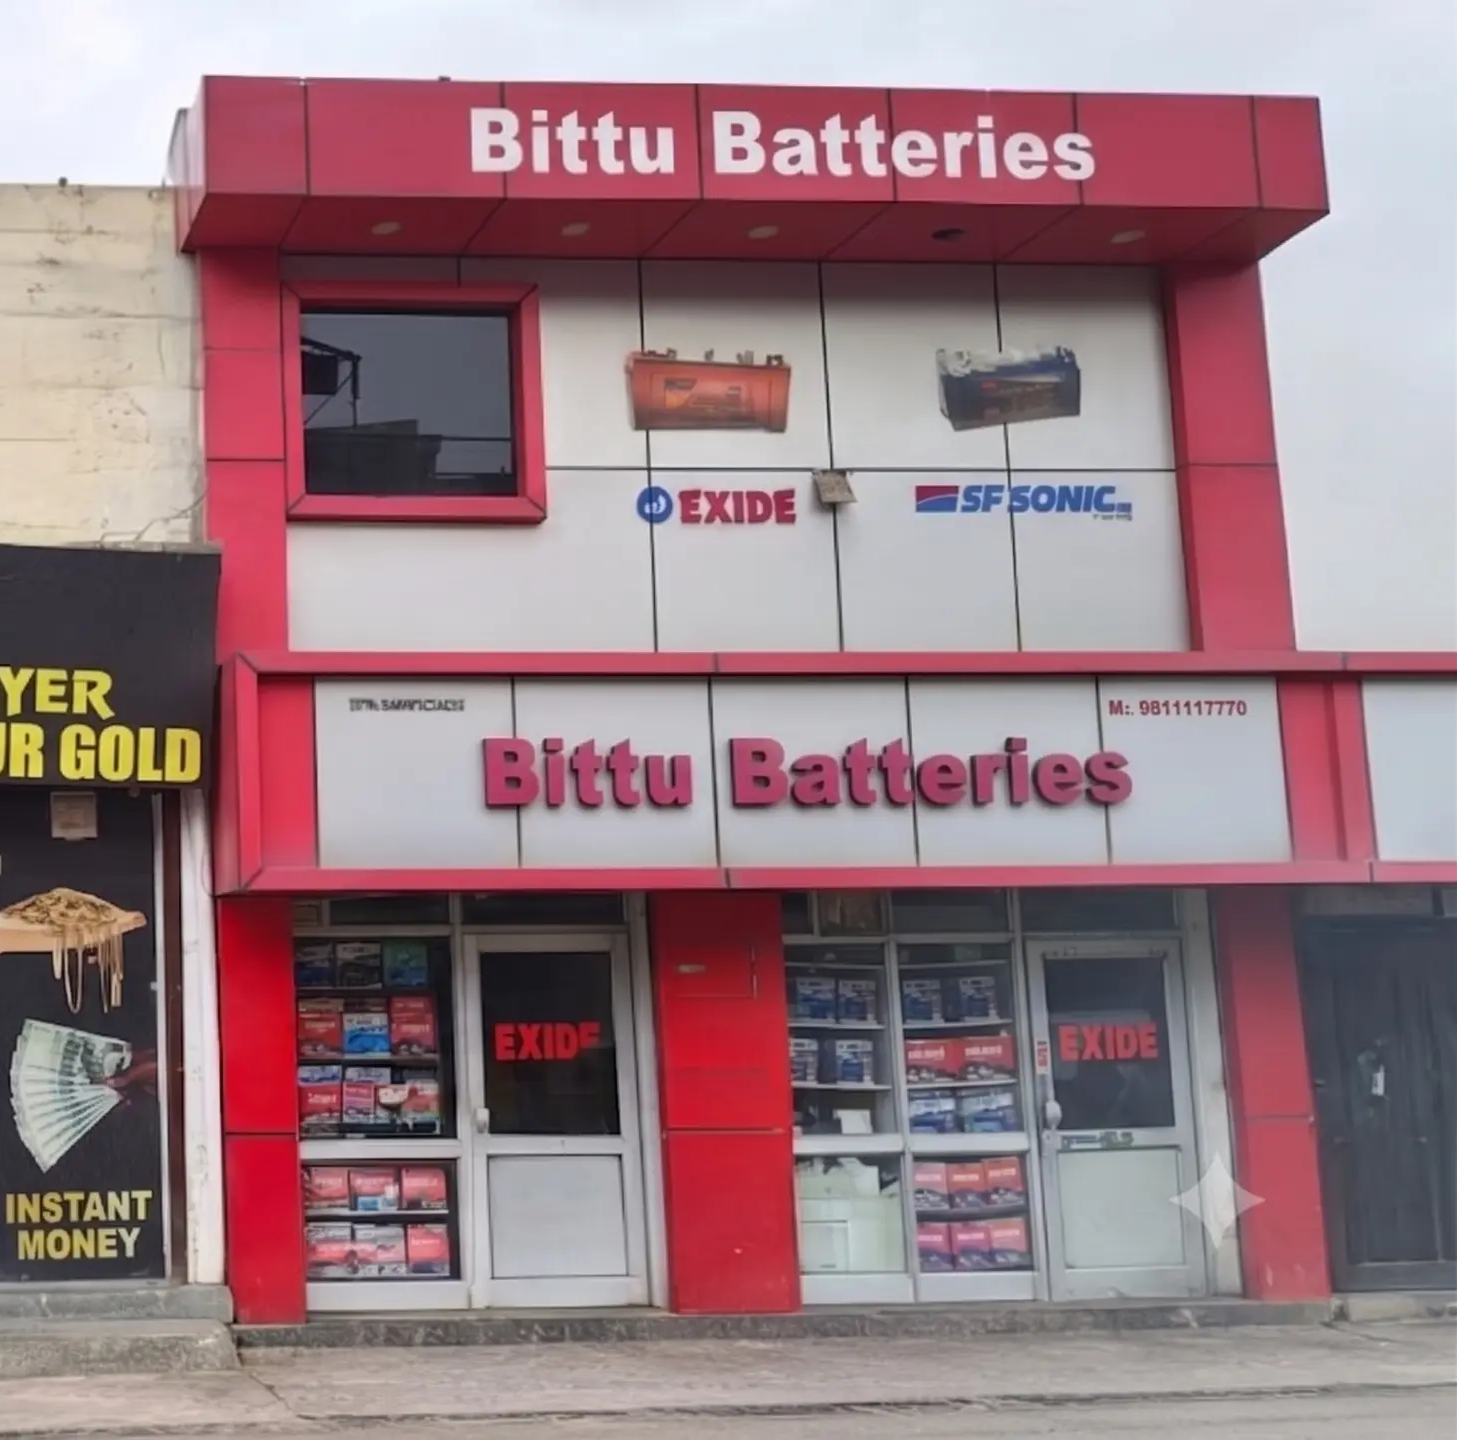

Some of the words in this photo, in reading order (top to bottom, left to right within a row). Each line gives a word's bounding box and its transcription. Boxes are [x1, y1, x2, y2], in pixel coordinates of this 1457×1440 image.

[470, 108, 675, 174] Bittu
[711, 110, 1095, 180] Batteries
[678, 488, 796, 525] EXIDE
[961, 484, 1005, 513] SF
[1008, 485, 1116, 513] SONIC
[1139, 700, 1248, 716] 9811117770
[59, 724, 202, 784] GOLD
[483, 737, 693, 810] Bittu
[729, 736, 1134, 810] Batteries
[1058, 1023, 1159, 1061] EXIDE
[5, 1189, 153, 1225] INSTANT
[17, 1227, 140, 1261] MONEY
